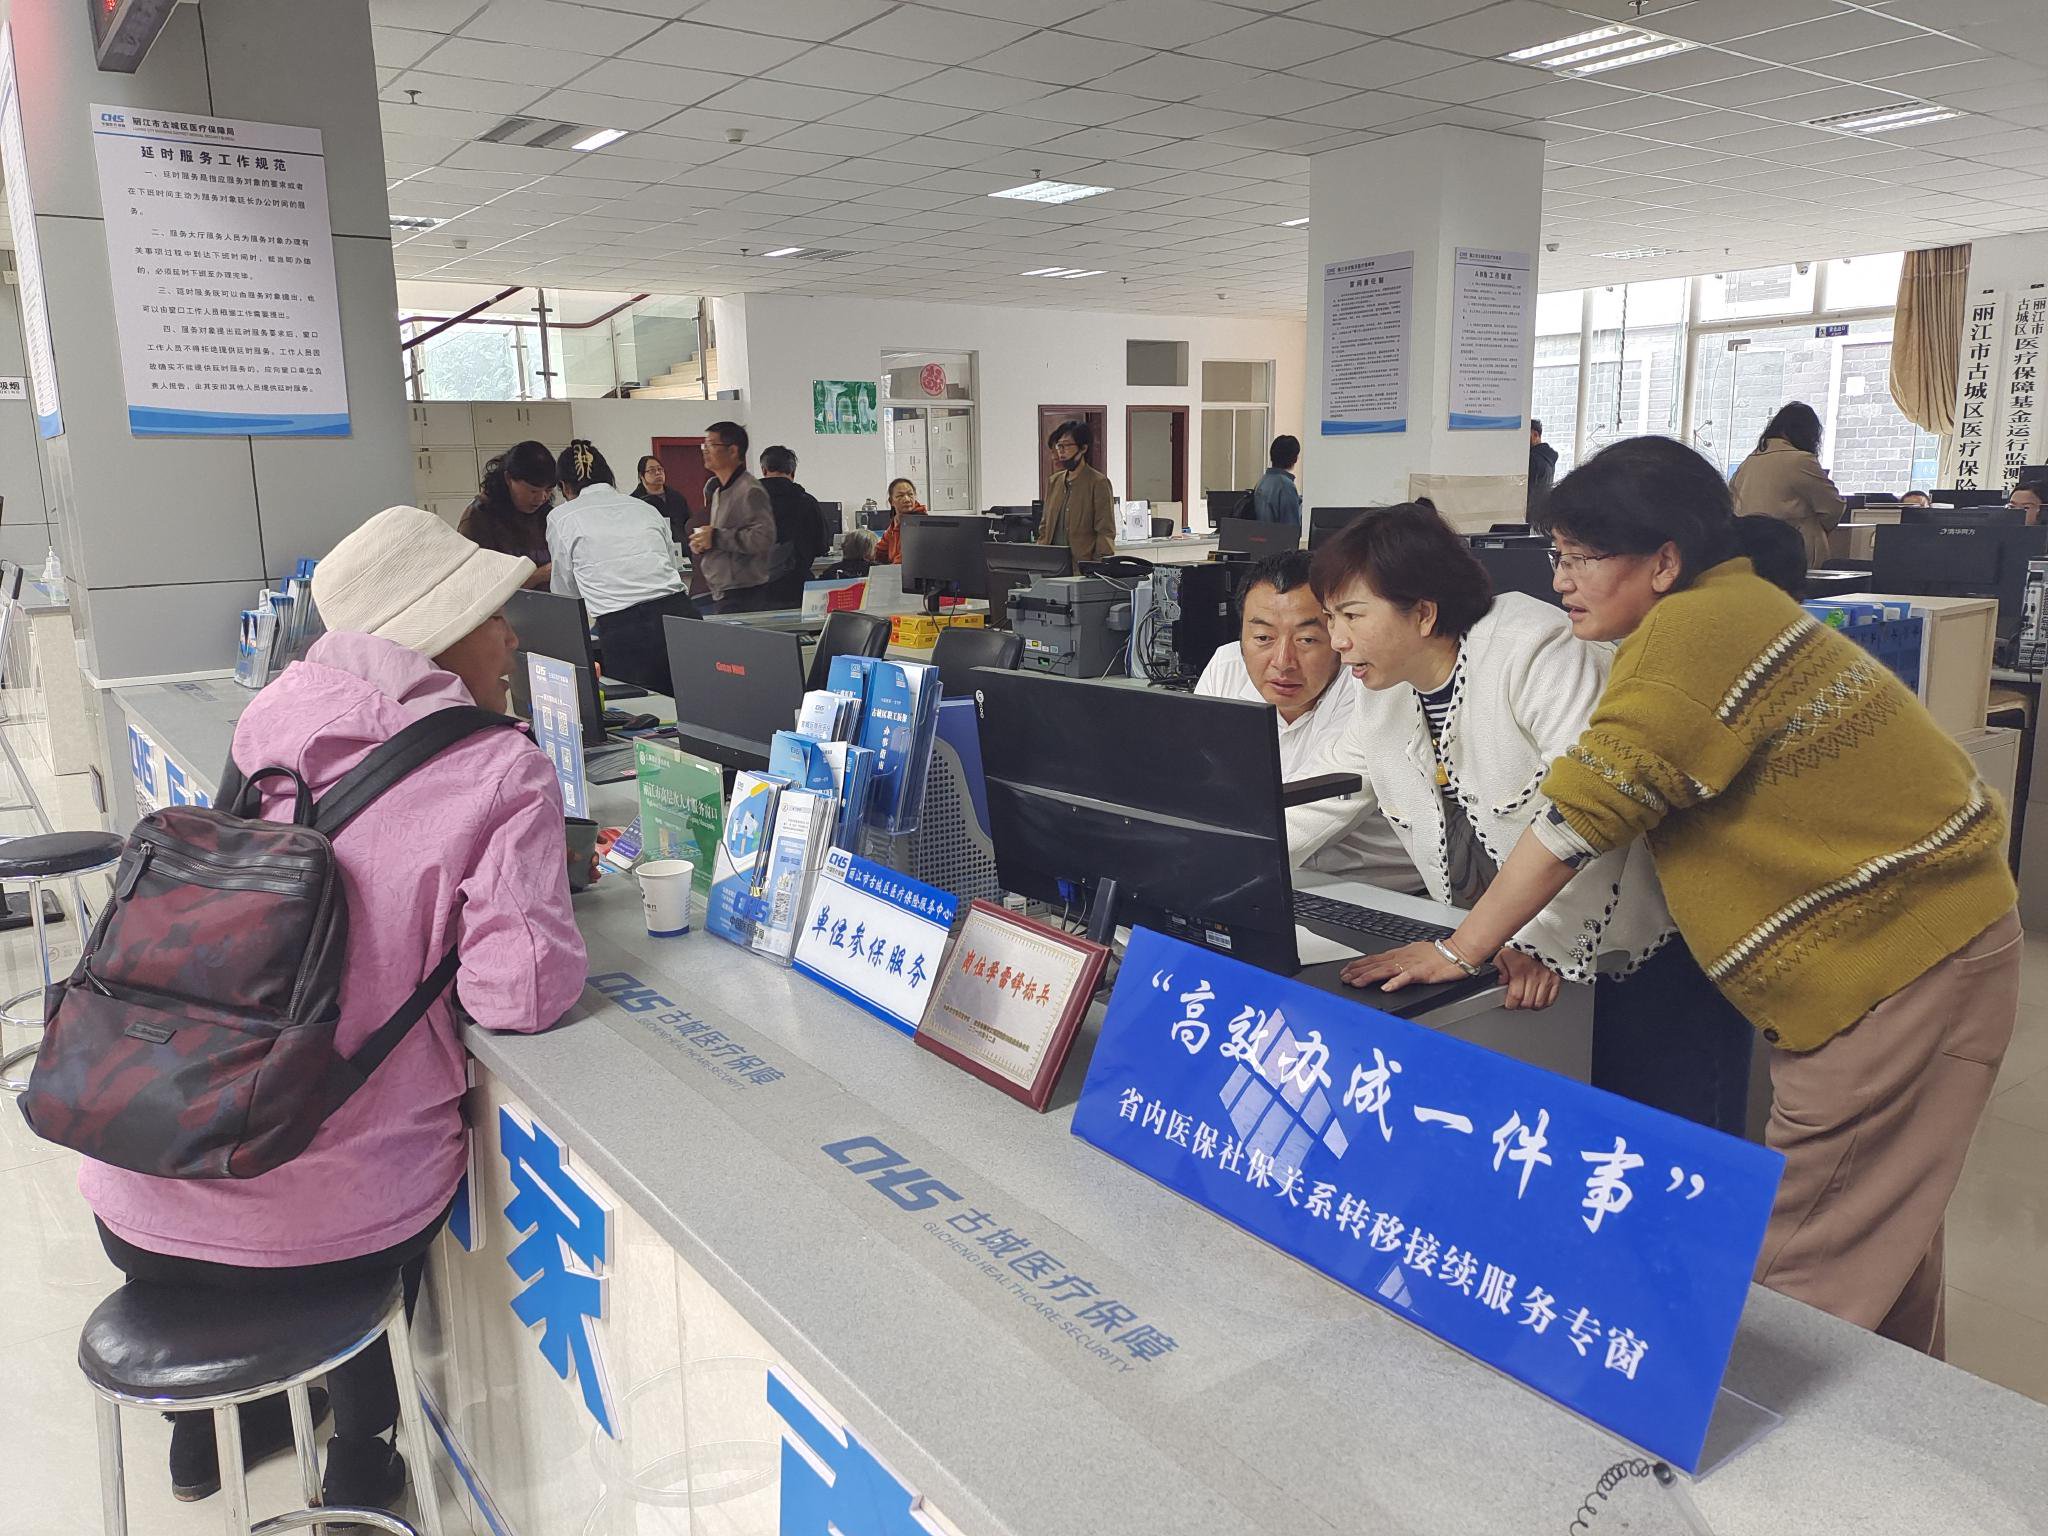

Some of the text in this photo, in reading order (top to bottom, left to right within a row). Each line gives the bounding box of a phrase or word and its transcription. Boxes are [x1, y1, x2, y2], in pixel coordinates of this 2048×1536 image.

[131, 116, 235, 136] 丽江市古城区医疗保障局
[139, 145, 288, 172] 延时服务工作规范
[2015, 298, 2030, 336] 古城区
[849, 867, 954, 921] 丽江市古城区医疗保险服务中心
[812, 905, 927, 988] 单位参保服务
[657, 1010, 786, 1086] 古城医疗保障
[1152, 969, 1705, 1234] “高效办成一件事”
[1118, 1087, 1649, 1382] 省内医保社保关系转移接续服务专窗
[946, 1207, 1180, 1362] 古城医疗保障
[1058, 1320, 1135, 1373] SECURITY
